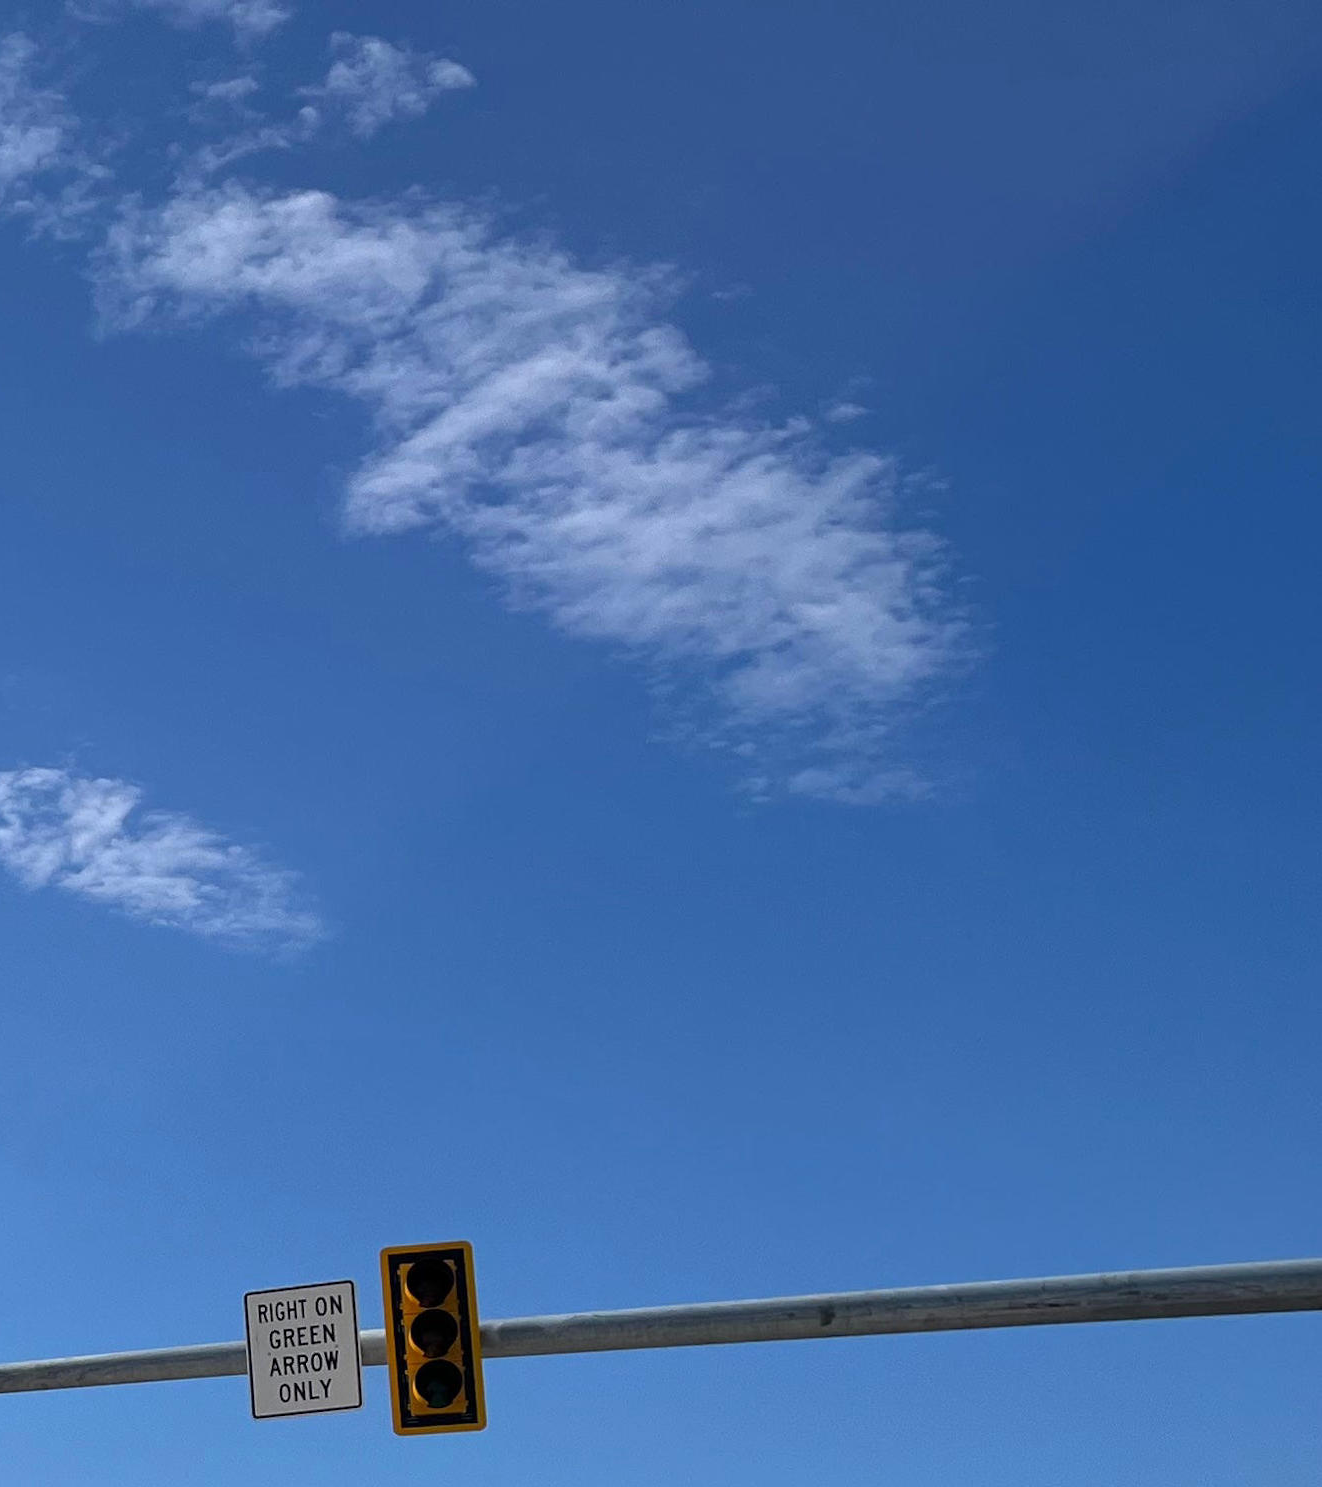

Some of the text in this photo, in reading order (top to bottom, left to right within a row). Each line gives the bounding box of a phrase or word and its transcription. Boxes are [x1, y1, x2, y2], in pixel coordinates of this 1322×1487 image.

[258, 1295, 342, 1323] RIGHT ON
[269, 1324, 335, 1349] GREEN
[270, 1350, 339, 1376] ARROW
[279, 1379, 331, 1402] ONLY
